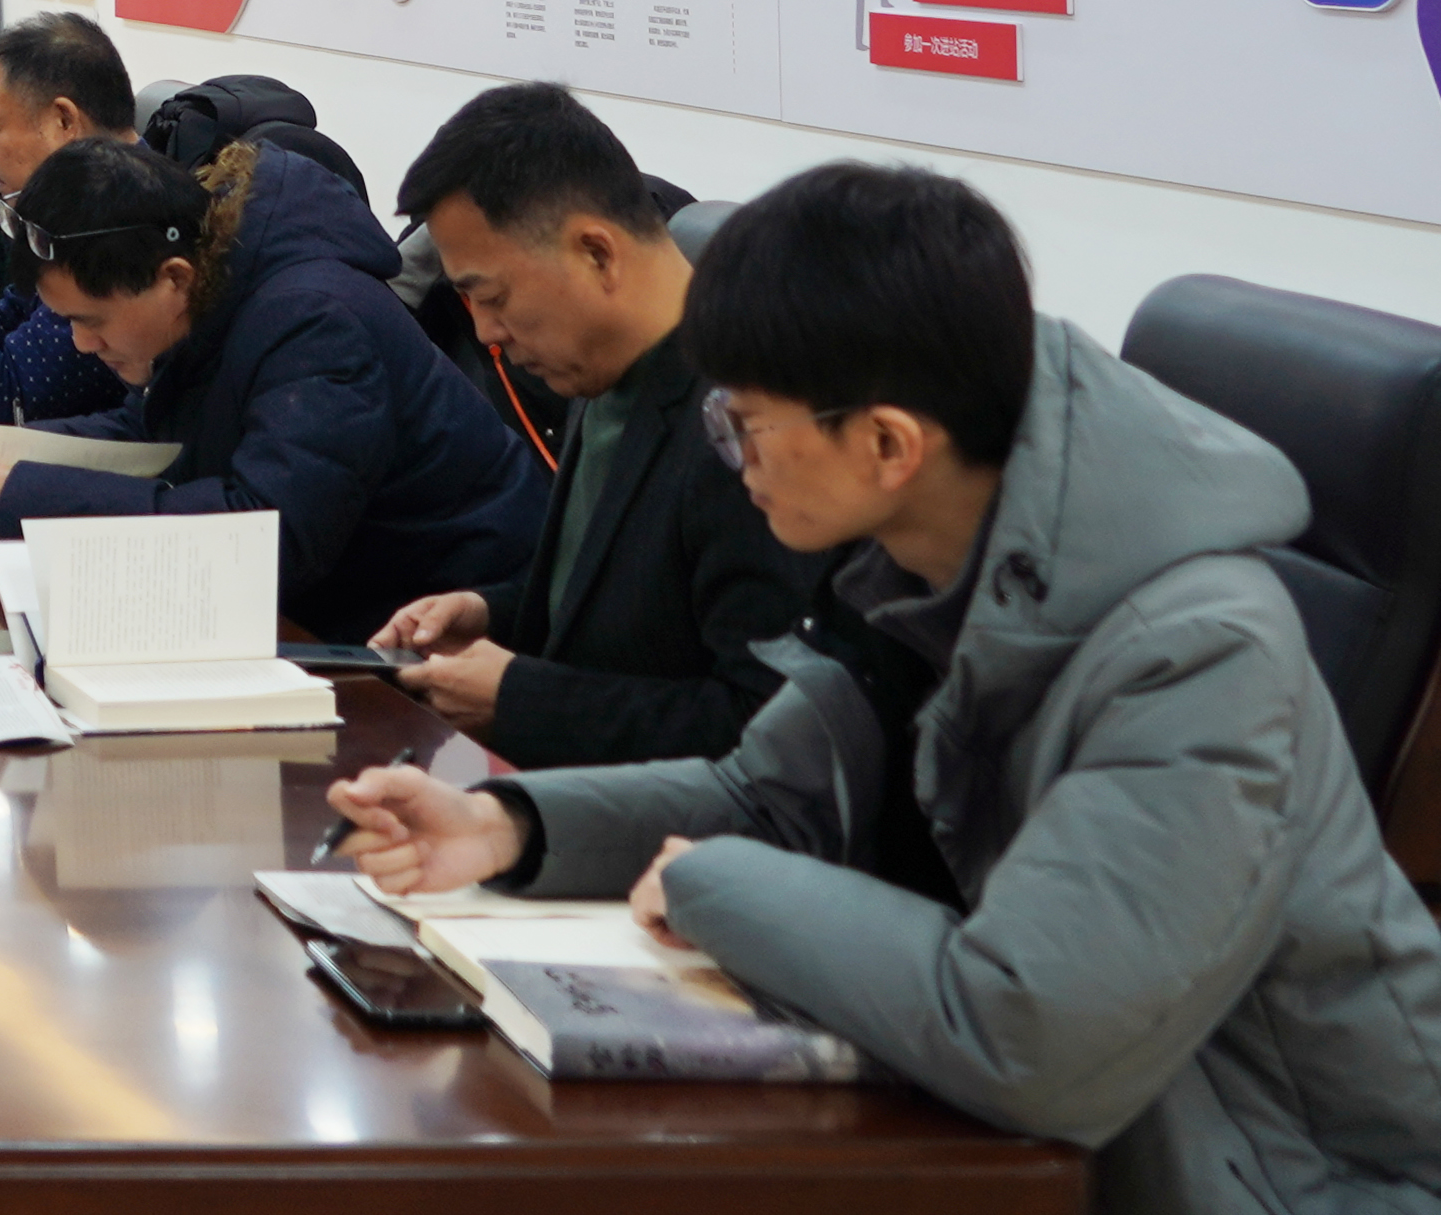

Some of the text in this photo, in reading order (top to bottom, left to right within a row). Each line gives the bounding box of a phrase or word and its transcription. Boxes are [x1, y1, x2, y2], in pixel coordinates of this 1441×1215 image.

[904, 33, 978, 59] 参加一次进站活动
